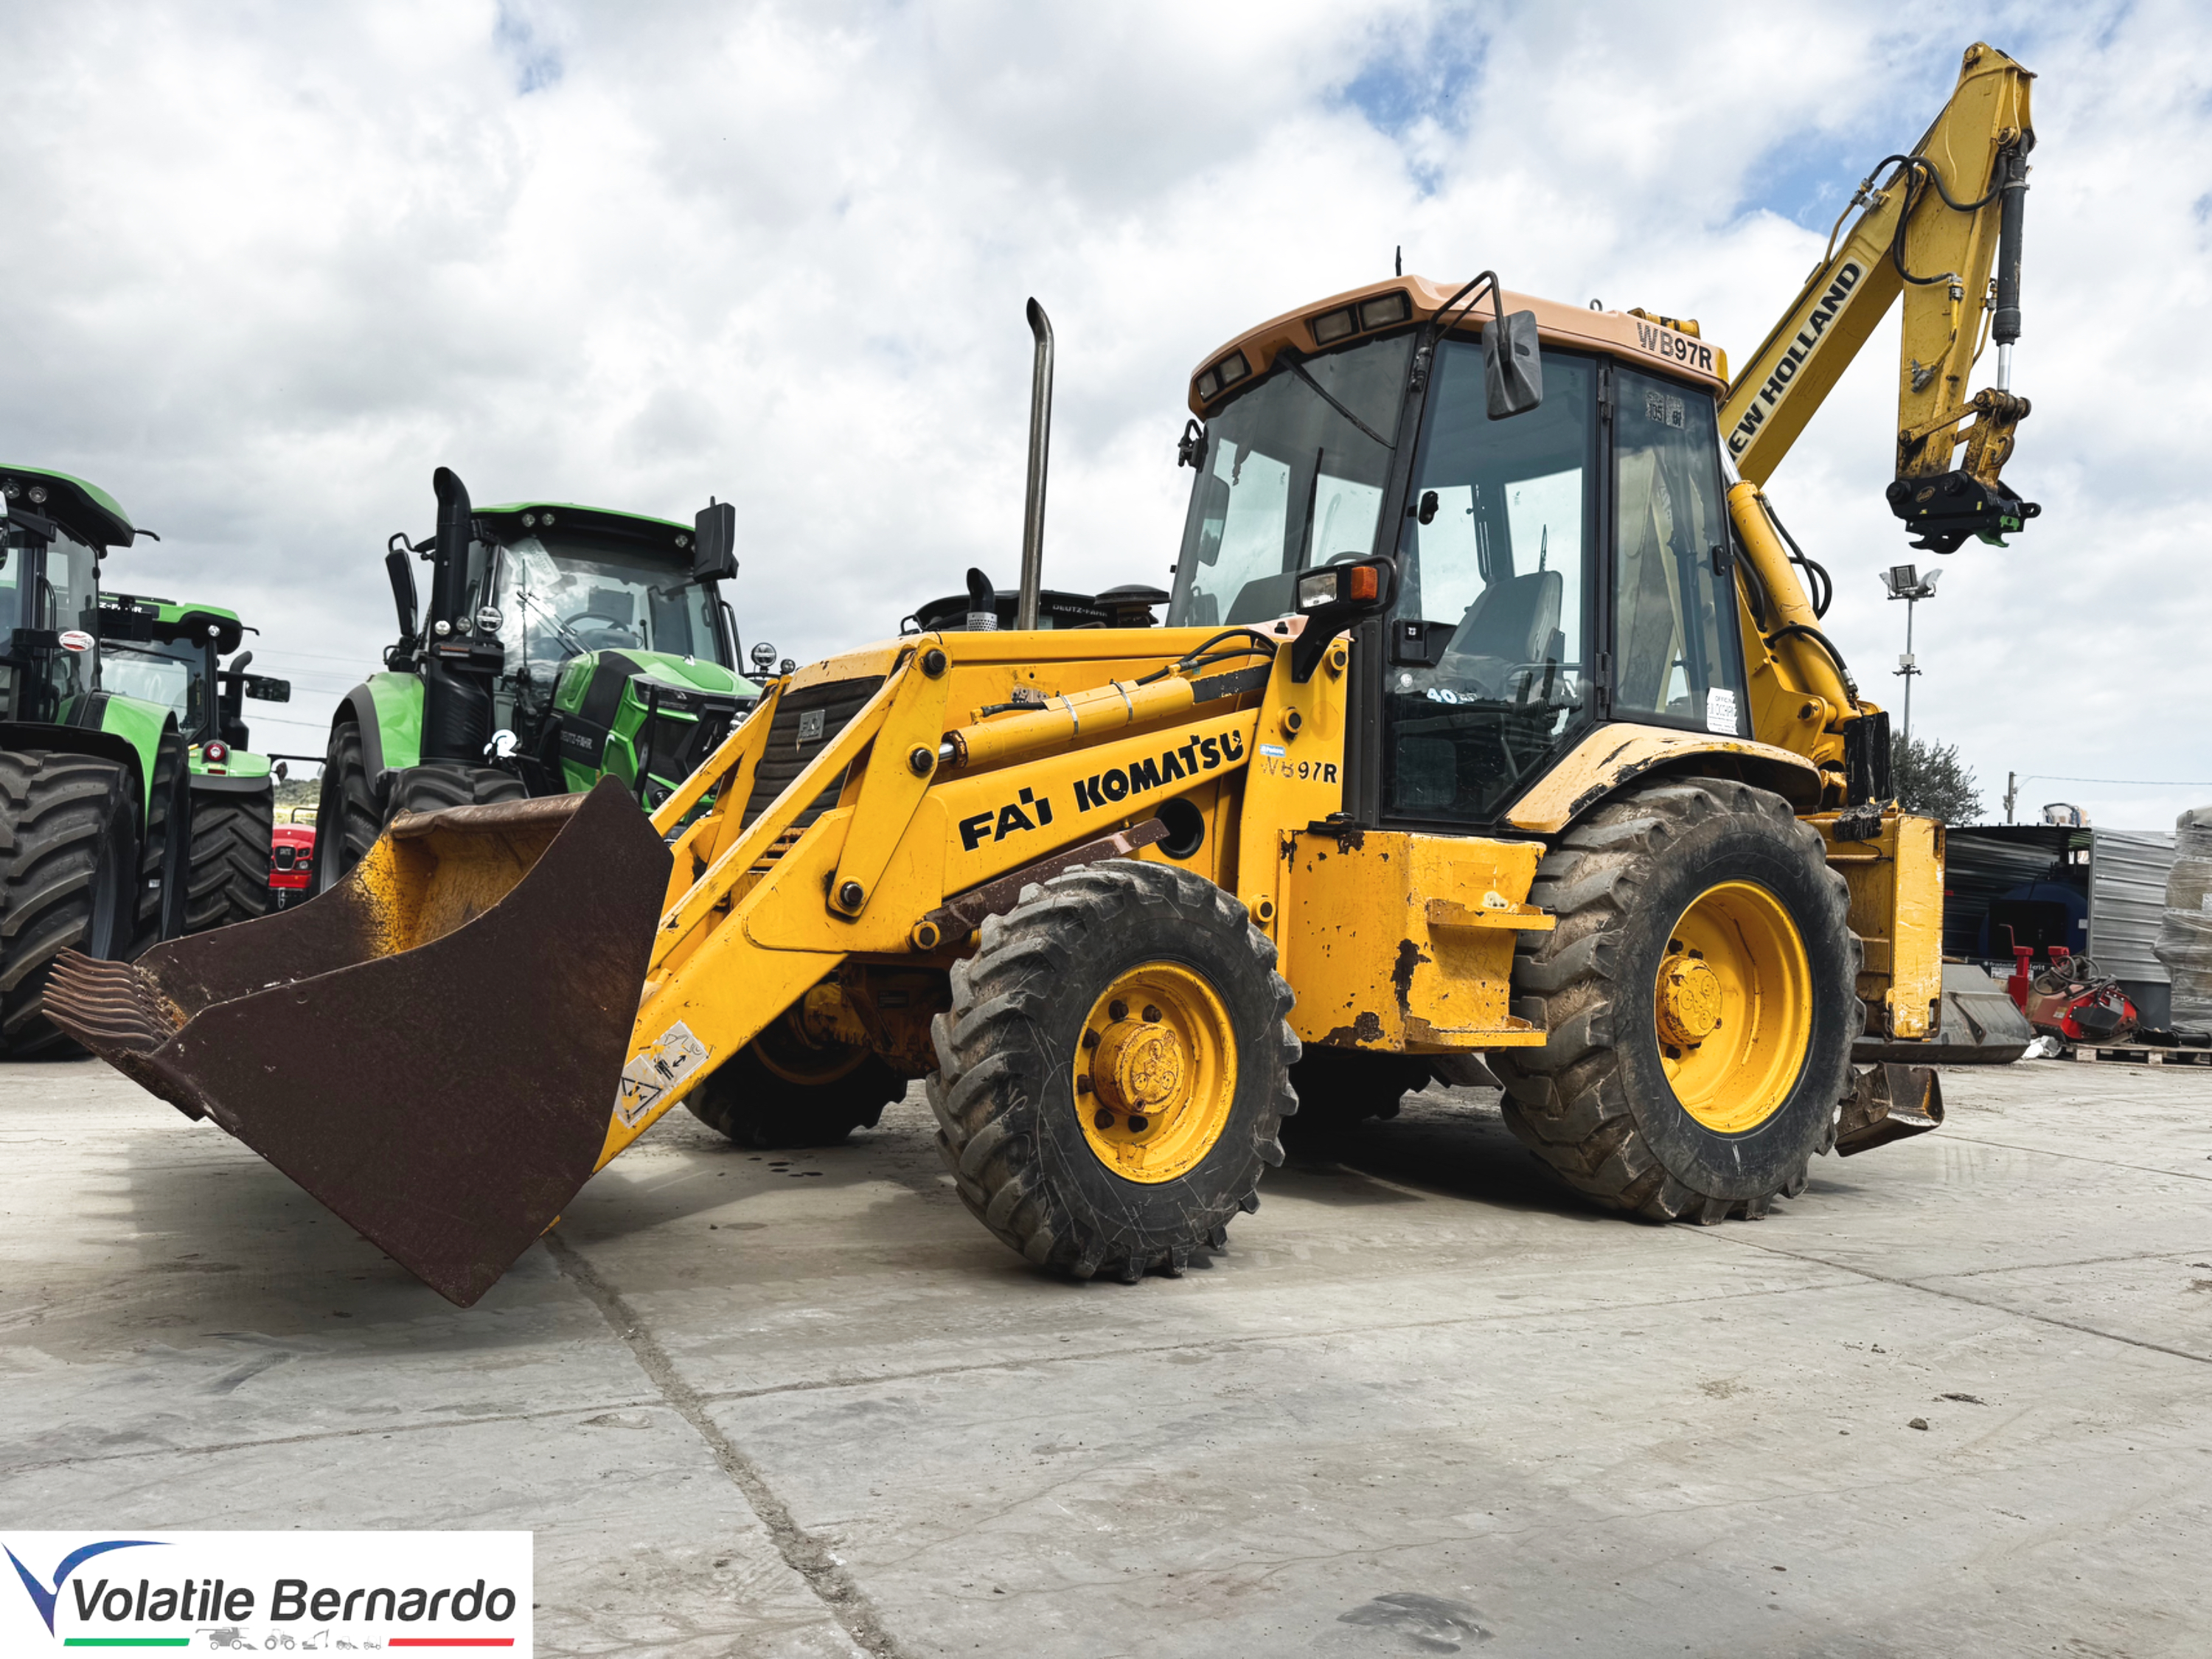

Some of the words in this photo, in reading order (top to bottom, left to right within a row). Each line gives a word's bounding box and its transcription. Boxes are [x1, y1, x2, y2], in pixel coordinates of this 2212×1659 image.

[1637, 321, 1712, 372] WB97R
[1728, 403, 1764, 460] EW
[1759, 263, 1860, 406] HOLLAND
[959, 787, 1053, 852] FAI
[1073, 729, 1244, 813] KOMATSU
